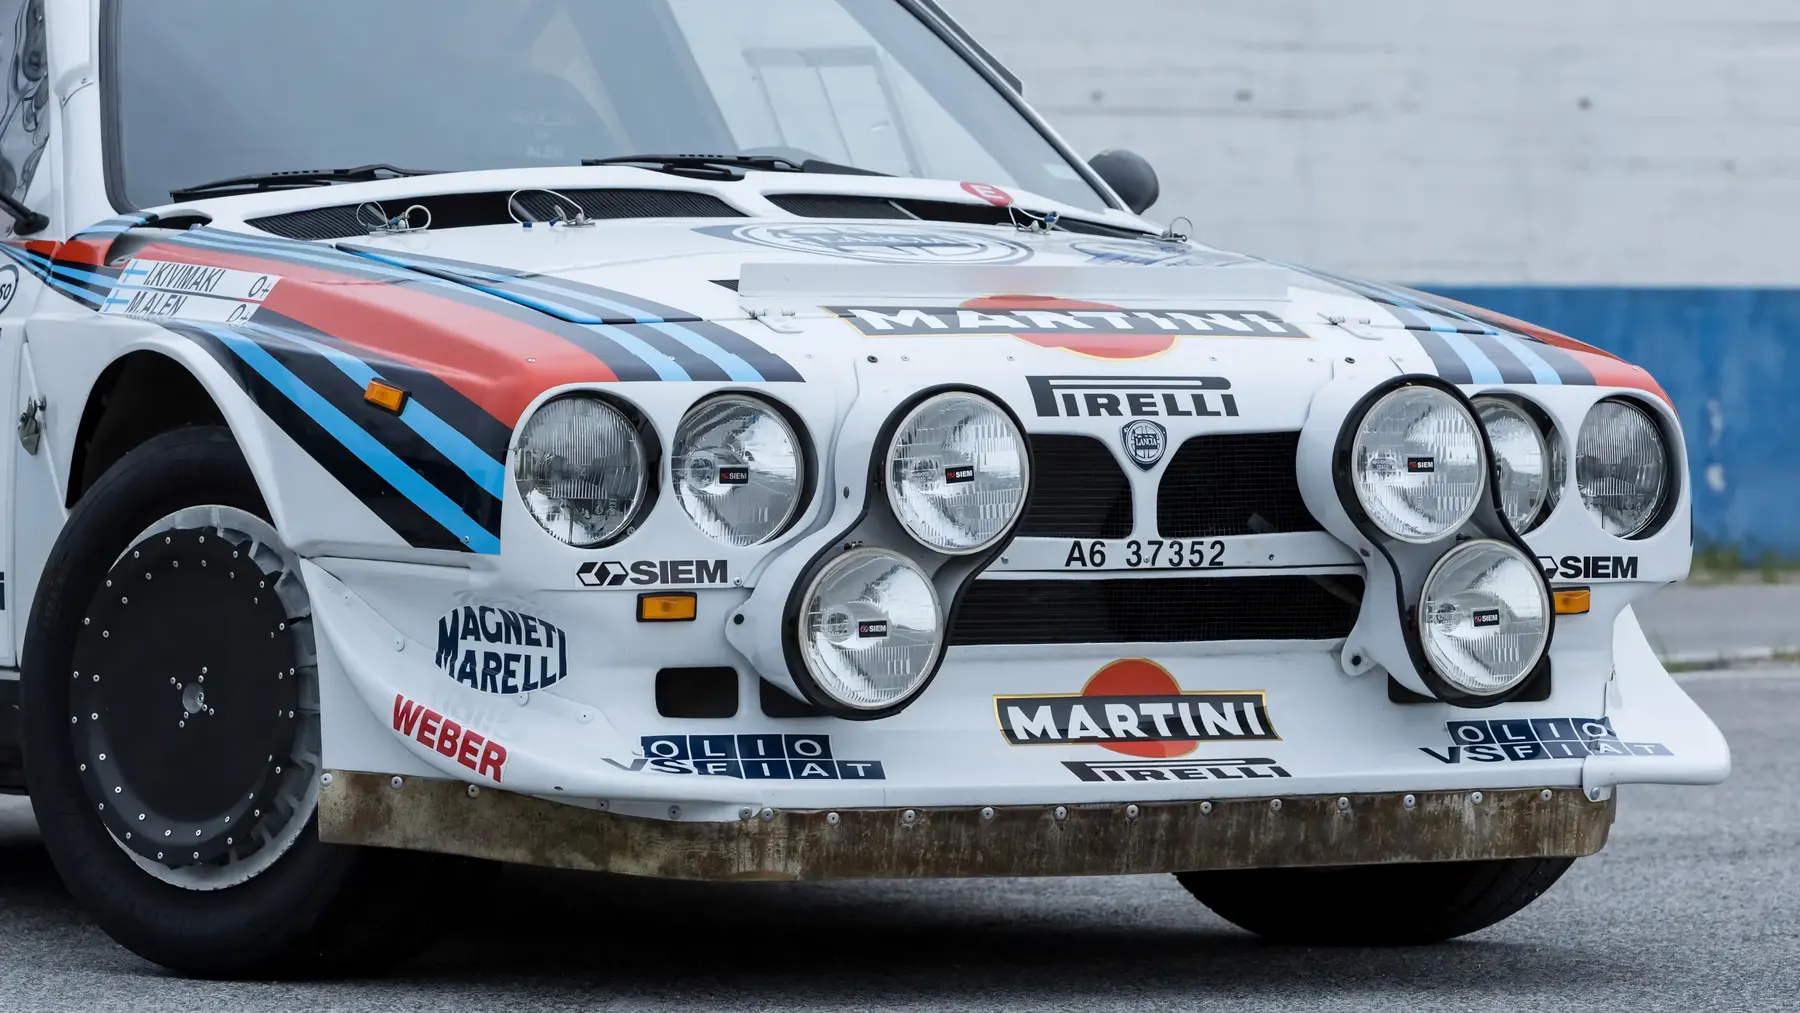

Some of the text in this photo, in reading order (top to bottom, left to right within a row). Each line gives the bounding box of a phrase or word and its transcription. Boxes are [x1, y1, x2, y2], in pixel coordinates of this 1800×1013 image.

[968, 184, 1006, 201] E
[124, 291, 189, 317] M.ALEN
[846, 308, 1290, 333] MARTINI
[1025, 375, 1240, 417] PIRELLI
[729, 472, 747, 480] SIEM
[955, 469, 973, 478] SIEM
[1417, 461, 1434, 469] SIEM
[1064, 539, 1226, 568] A6 37352
[629, 559, 729, 585] SIEM
[1559, 555, 1639, 579] SIEM
[437, 605, 568, 653] MAGNETI
[868, 624, 887, 632] SIEM
[1481, 614, 1498, 622] SIEM
[434, 645, 568, 694] MARELLI
[1006, 702, 1267, 740] MARTINI
[1457, 722, 1609, 743] OLIO
[392, 693, 508, 783] WEBER
[650, 739, 824, 758] OLIO
[1060, 757, 1293, 782] PIRELLI
